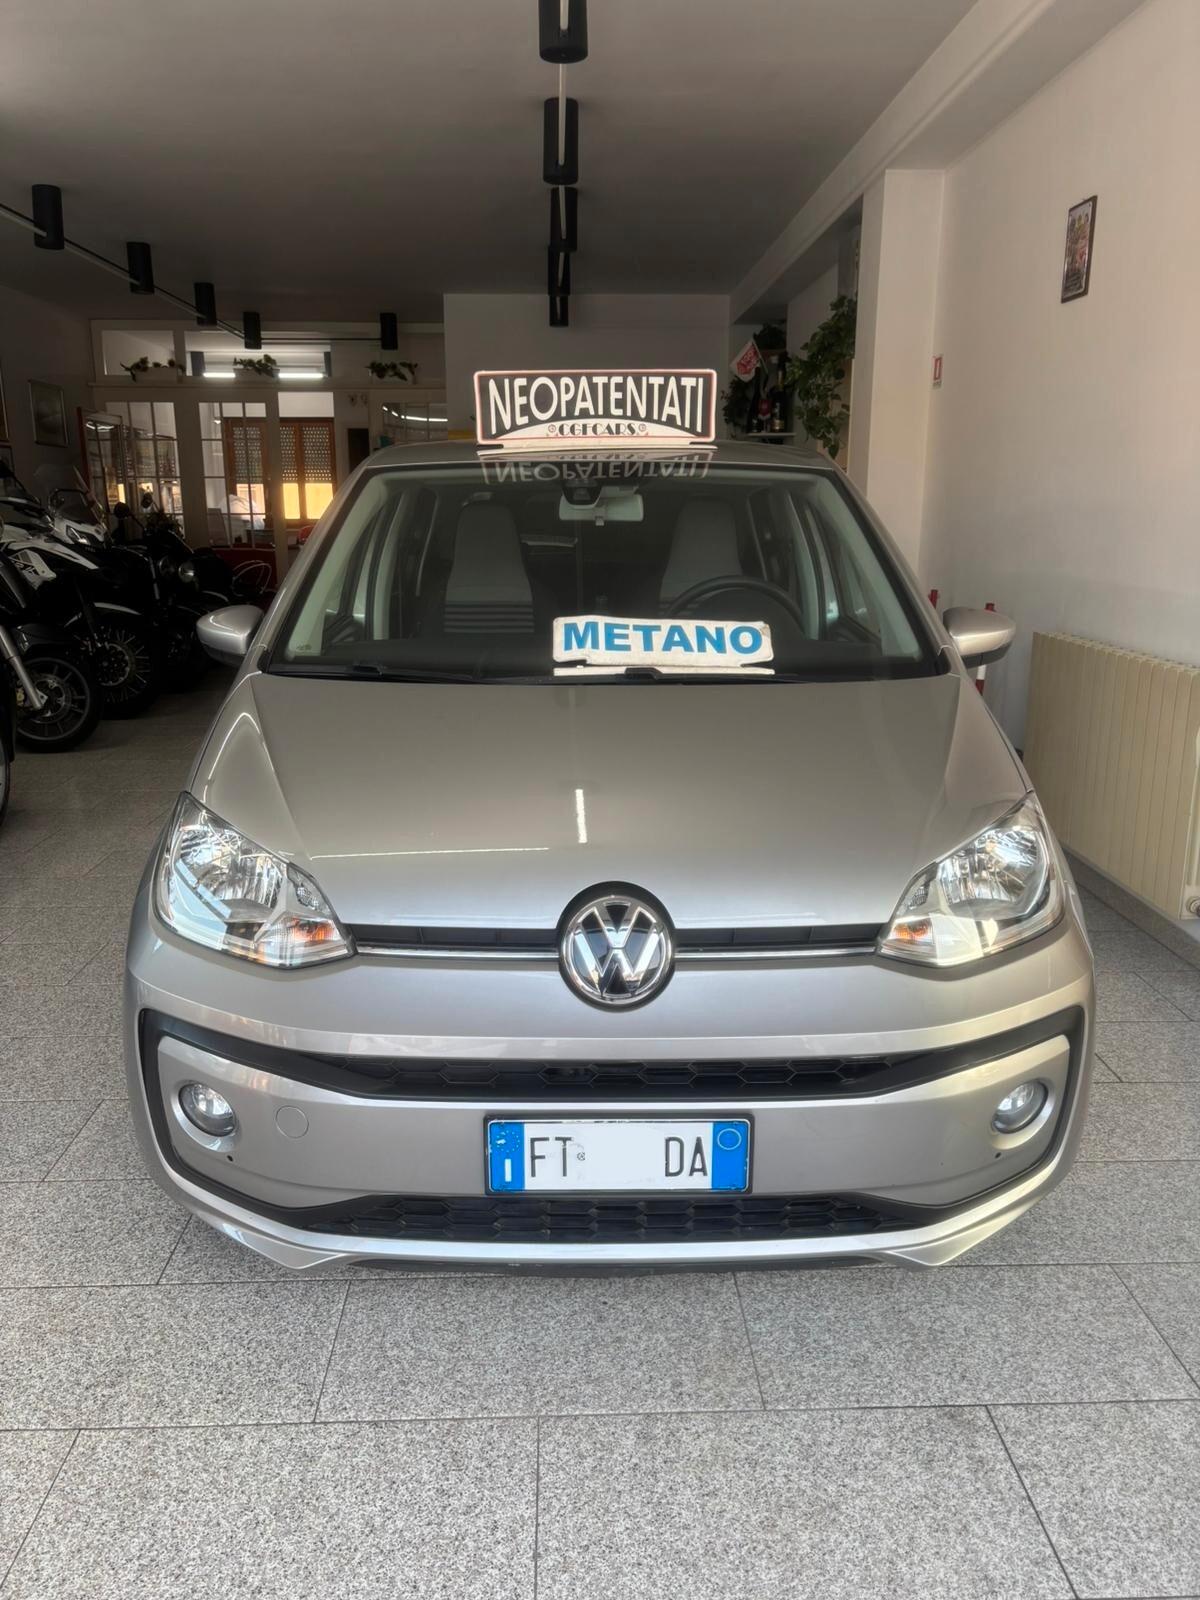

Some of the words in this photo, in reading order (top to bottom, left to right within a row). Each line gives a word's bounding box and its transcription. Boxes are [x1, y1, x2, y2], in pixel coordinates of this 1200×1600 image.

[488, 375, 704, 436] NEOPATENTATI
[563, 621, 763, 655] METANO
[566, 896, 668, 1002] VW
[664, 1136, 708, 1178] DA
